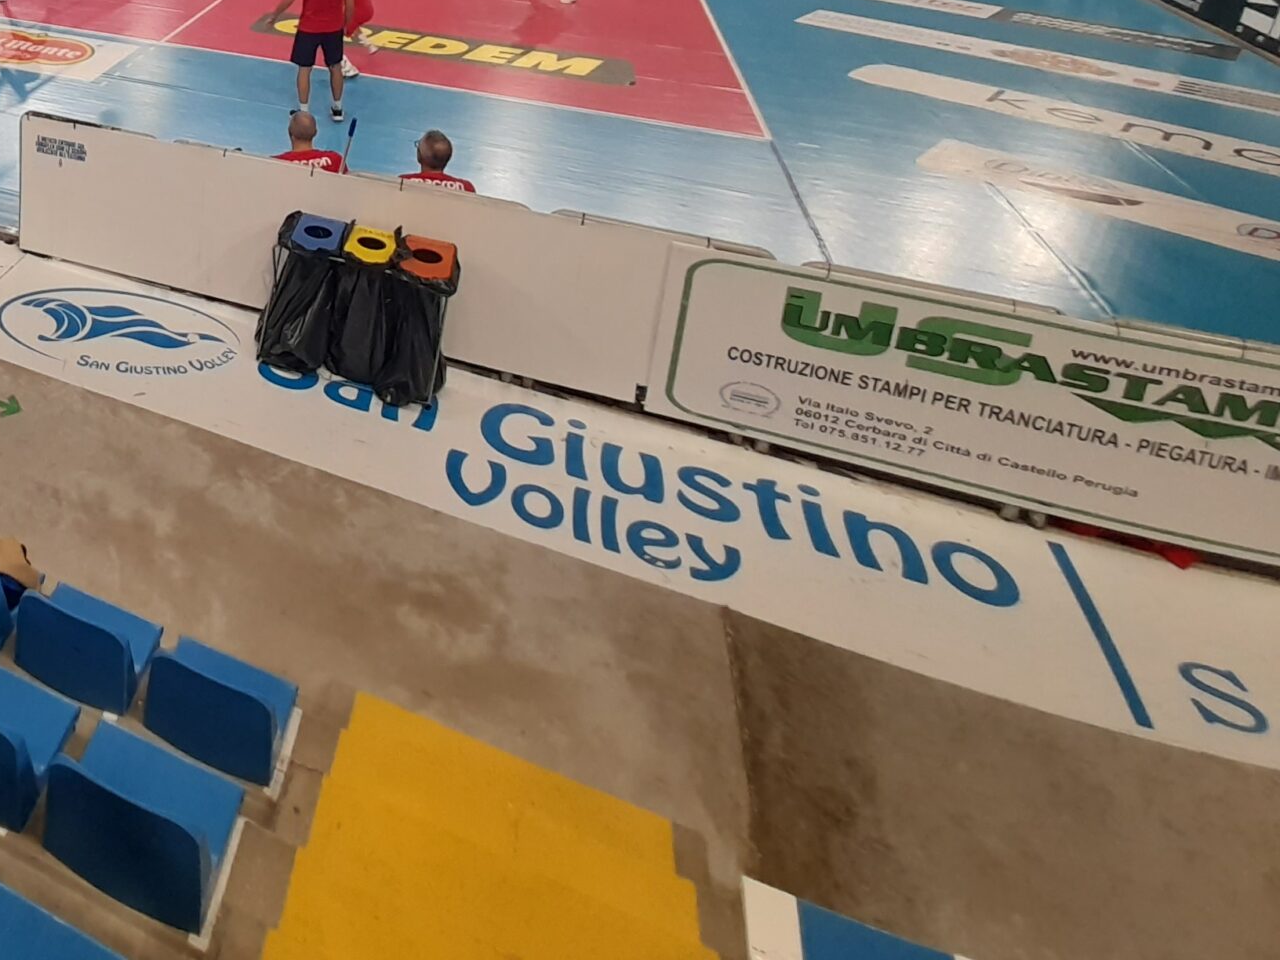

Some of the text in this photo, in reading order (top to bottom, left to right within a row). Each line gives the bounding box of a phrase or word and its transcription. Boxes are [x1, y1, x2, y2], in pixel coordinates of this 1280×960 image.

[727, 346, 853, 387] COSTRUZIONE
[857, 374, 927, 404] STAMPI
[930, 391, 973, 415] PER
[977, 401, 1119, 449] TRANCIATURA
[1136, 438, 1248, 475] PIEGATURA
[794, 418, 815, 430] Tel
[795, 407, 840, 425] 06012
[844, 419, 907, 441] Cerbara
[976, 452, 993, 463] di
[998, 456, 1068, 481] Castello
[1072, 474, 1139, 498] Perugia
[798, 395, 821, 409] Via
[922, 426, 934, 435] 2
[445, 448, 742, 582] Volley
[480, 402, 1020, 608] Giustino
